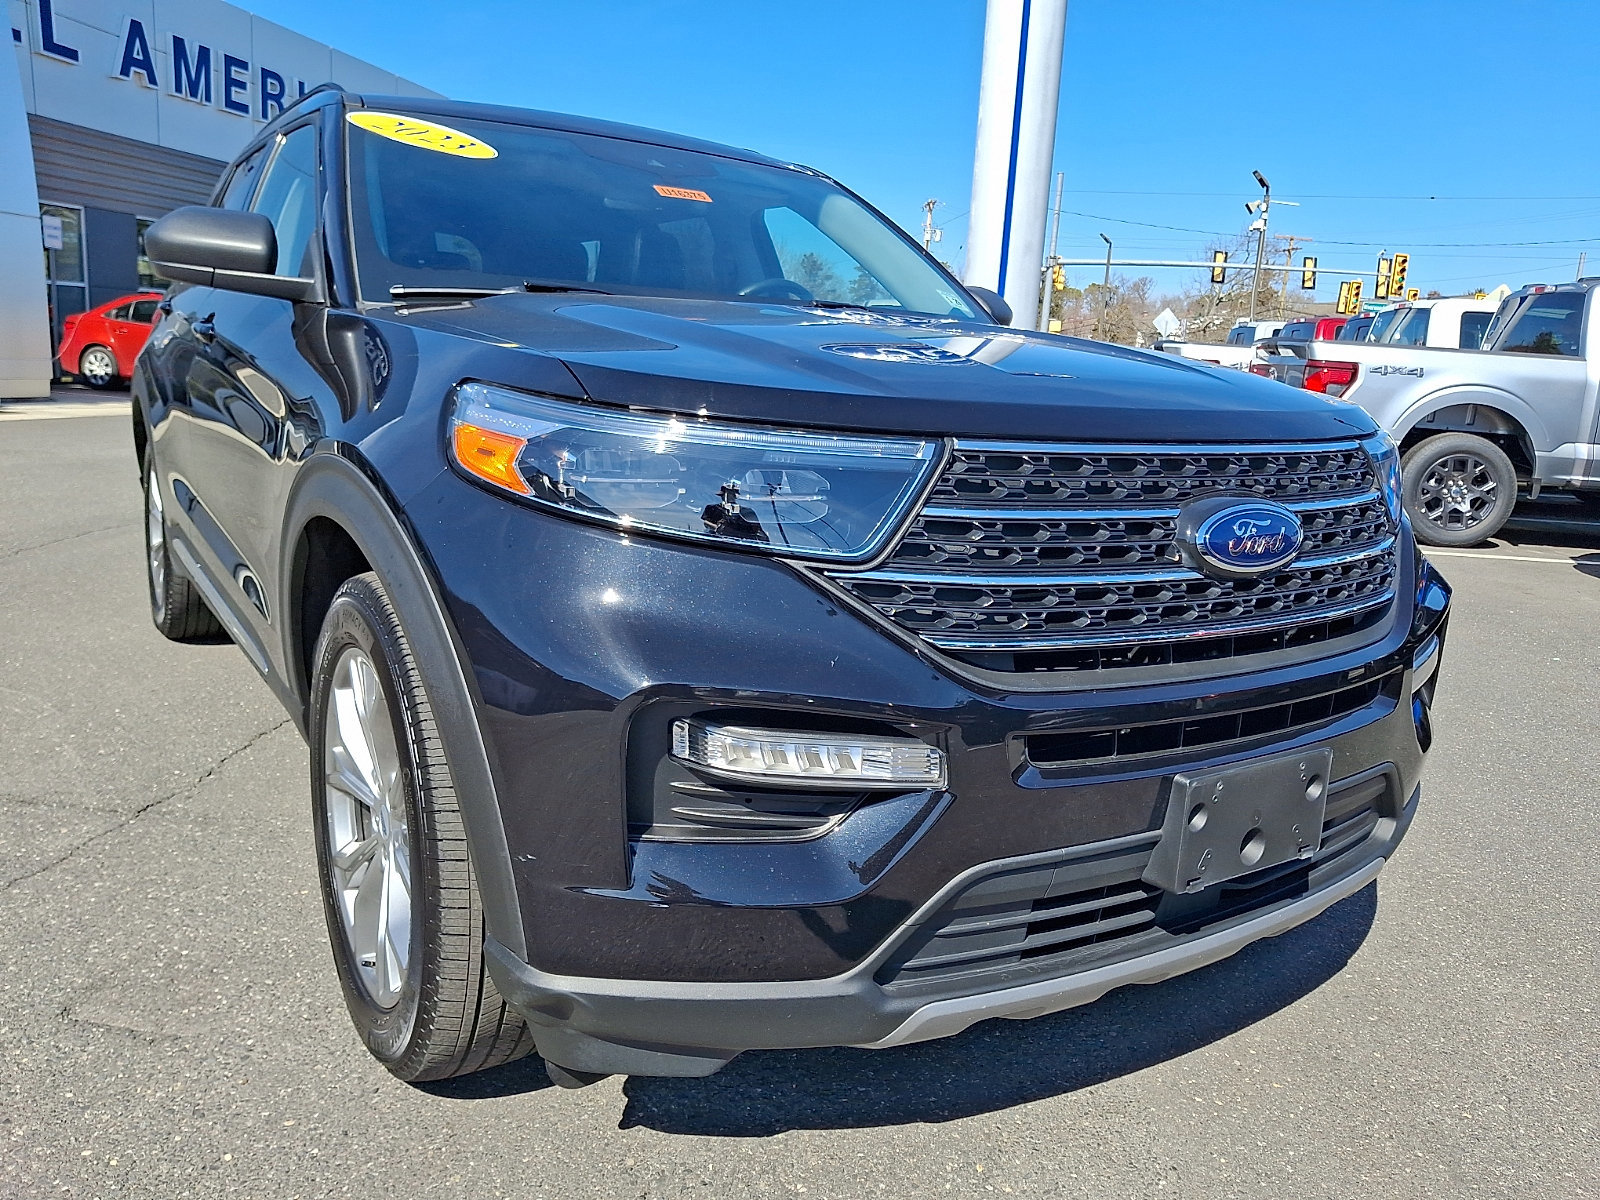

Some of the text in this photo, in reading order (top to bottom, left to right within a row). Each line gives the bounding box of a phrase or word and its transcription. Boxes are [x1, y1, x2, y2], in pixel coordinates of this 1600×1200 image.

[370, 121, 478, 151] 2023
[661, 187, 707, 201] U16375
[1228, 518, 1286, 557] Ford
